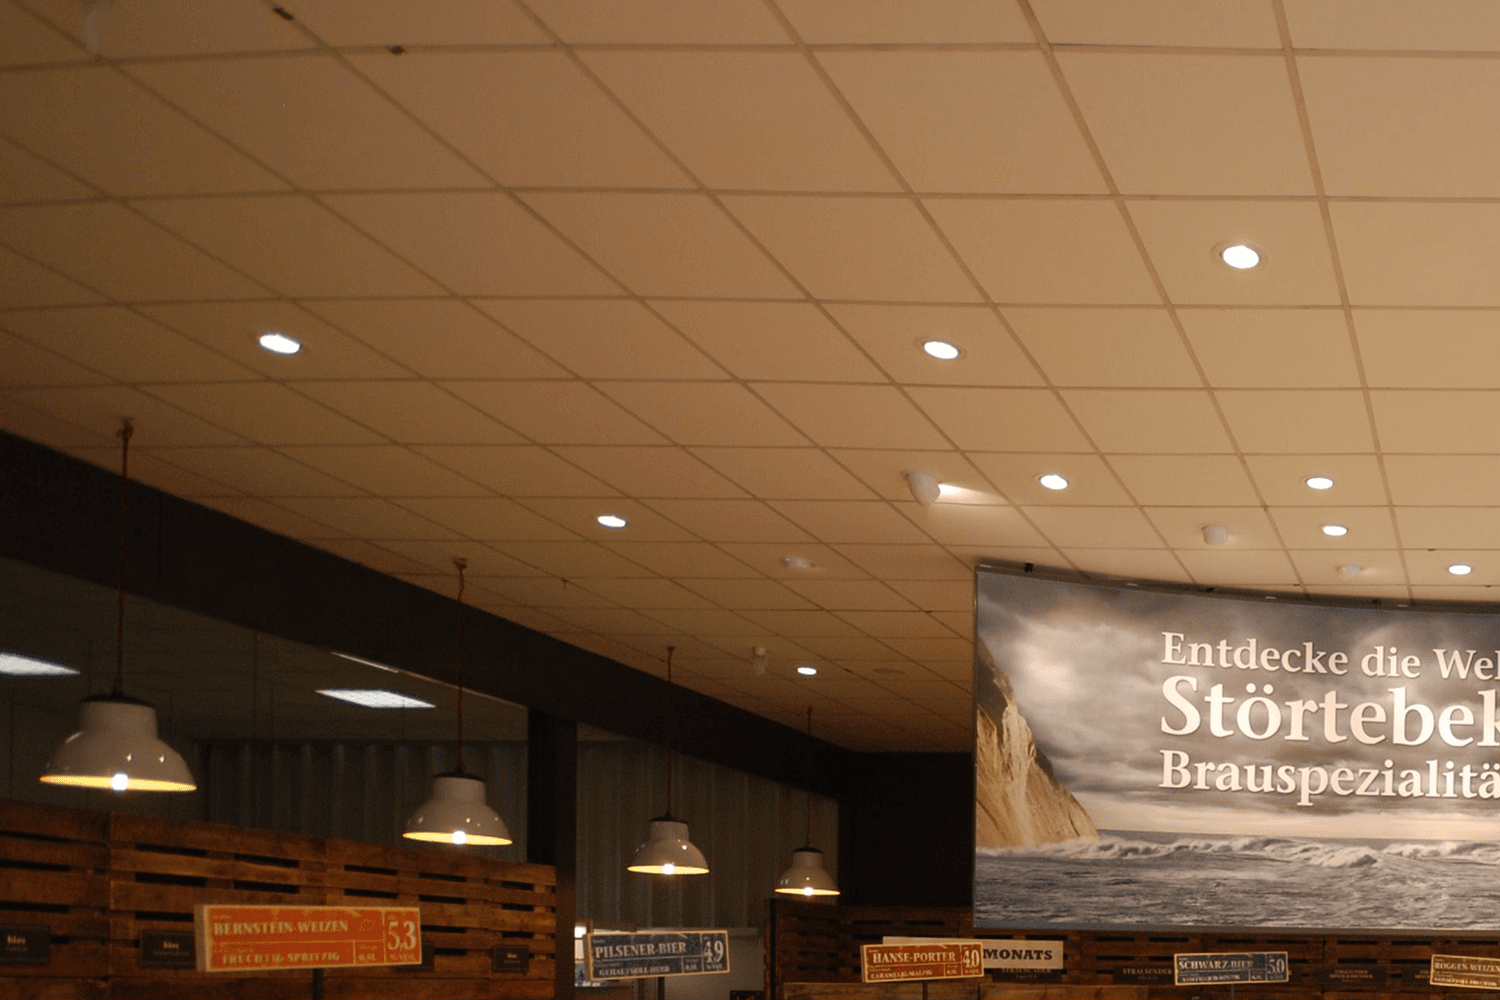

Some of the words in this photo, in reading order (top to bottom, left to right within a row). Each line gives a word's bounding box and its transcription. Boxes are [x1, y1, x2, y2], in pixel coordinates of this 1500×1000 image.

[1161, 631, 1349, 676] Entdecke
[1361, 646, 1421, 678] die
[214, 920, 349, 936] BERNSTEIN-WEIZEN
[594, 942, 687, 959] PILSENER-BIER
[983, 948, 1053, 961] MONATS
[873, 951, 956, 964] HANSE-PORTER
[1178, 960, 1254, 970] SCHWARZ-BIER
[1434, 961, 1500, 973] ROGGEN-WEIZEN
